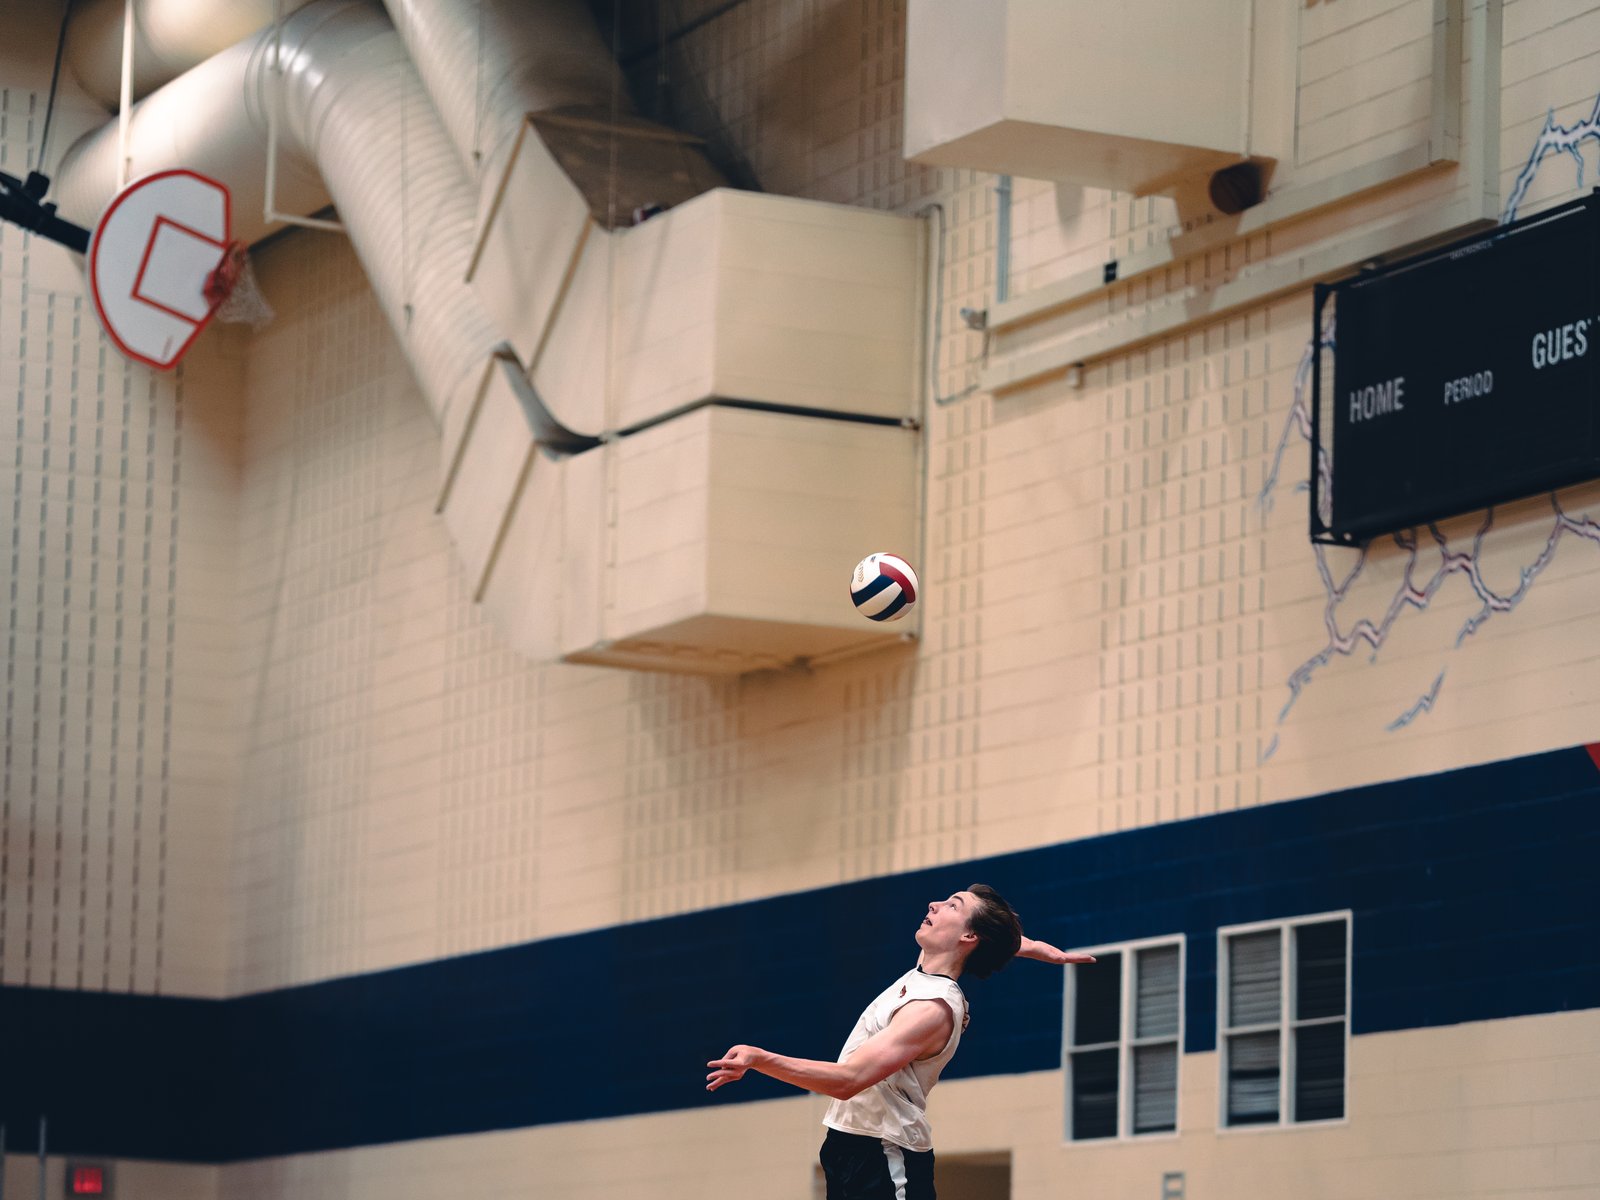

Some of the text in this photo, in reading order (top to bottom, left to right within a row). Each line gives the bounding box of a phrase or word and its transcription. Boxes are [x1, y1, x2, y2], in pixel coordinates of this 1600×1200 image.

[1532, 318, 1600, 369] GUES
[1350, 377, 1405, 423] HOME
[1444, 370, 1493, 405] PERIOD
